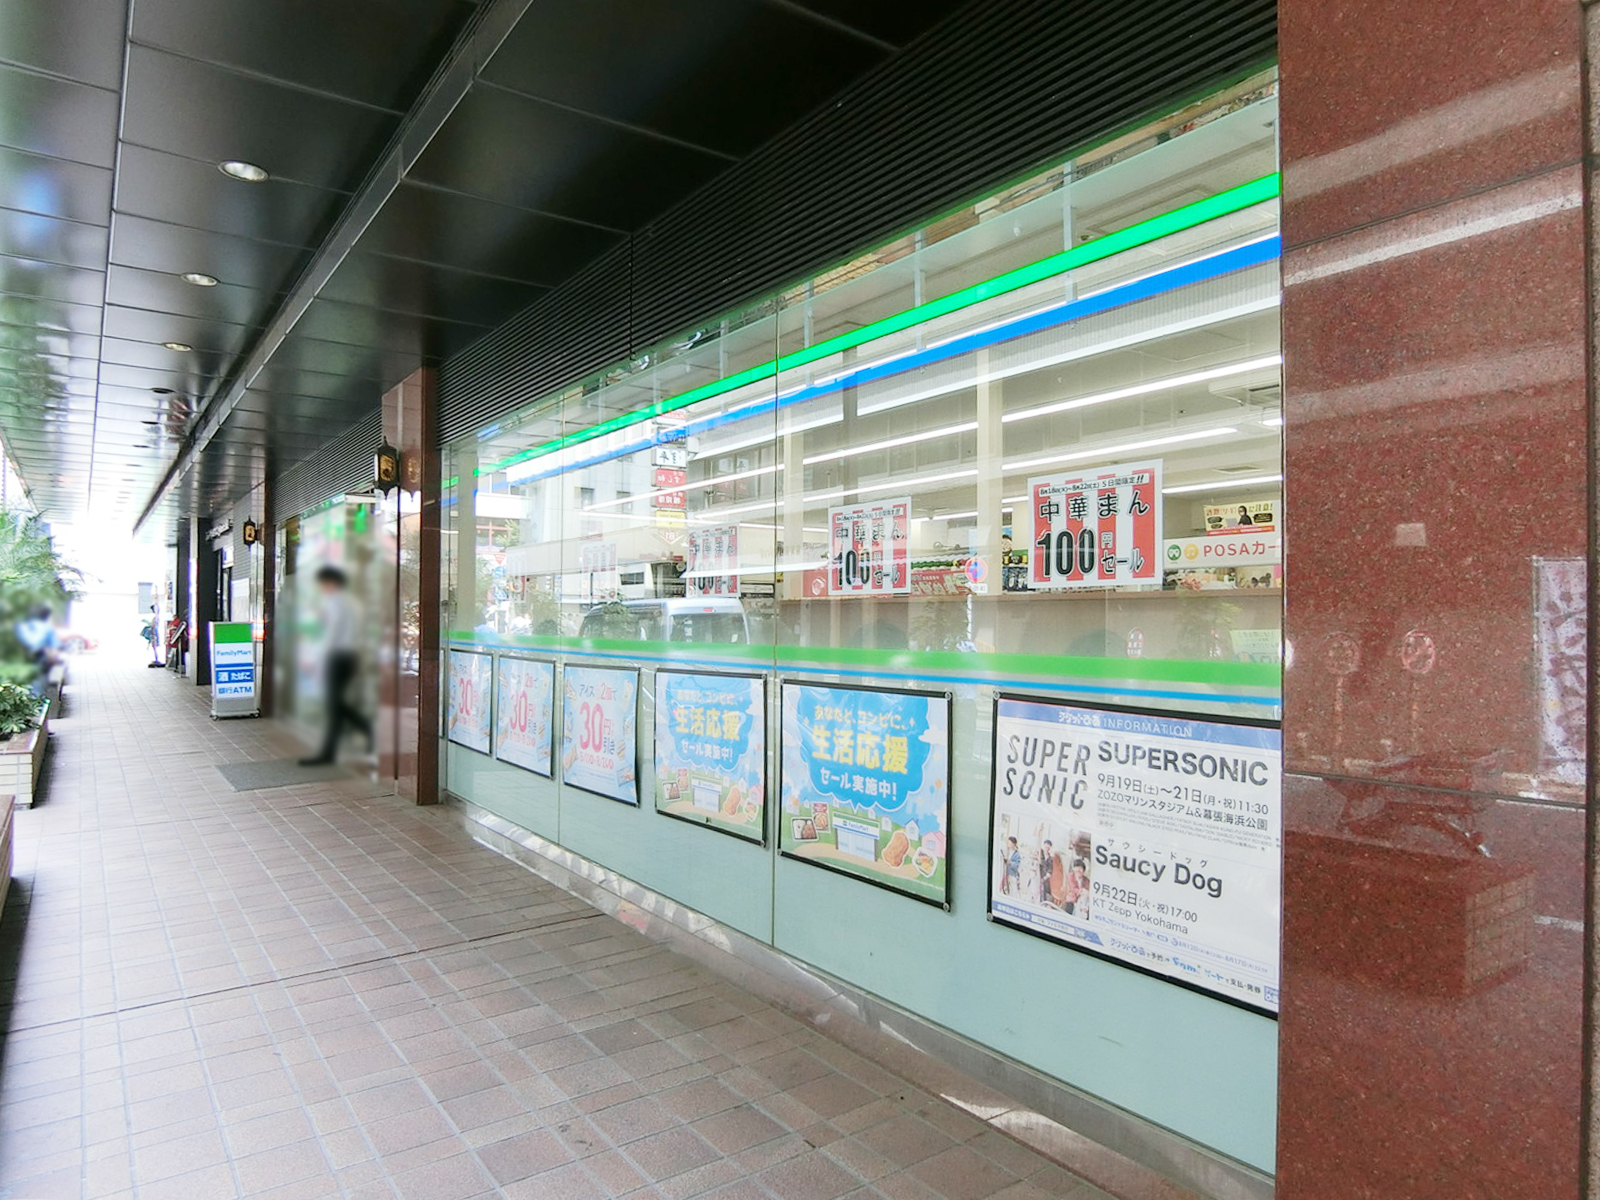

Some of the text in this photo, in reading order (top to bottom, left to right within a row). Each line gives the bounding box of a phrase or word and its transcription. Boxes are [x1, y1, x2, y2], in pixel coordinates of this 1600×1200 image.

[1039, 490, 1149, 522] 中華まん
[836, 519, 905, 543] 中華まん
[832, 549, 870, 586] 100
[1036, 527, 1095, 577] 100
[1101, 547, 1144, 574] セール
[216, 648, 252, 657] FamilyMart
[218, 686, 253, 695] 銀行ATM
[675, 707, 740, 741] 生活応援
[1103, 717, 1193, 738] INFORMATION
[812, 724, 909, 775] 生活応援
[1006, 734, 1091, 776] SUPER
[1097, 740, 1269, 787] SUPERSONIC
[820, 767, 898, 801] セール実施中!
[1003, 767, 1088, 811] SONIC
[1095, 844, 1223, 898] Saucy Dog
[1108, 900, 1132, 921] Zepp
[1134, 909, 1189, 935] Yokohama
